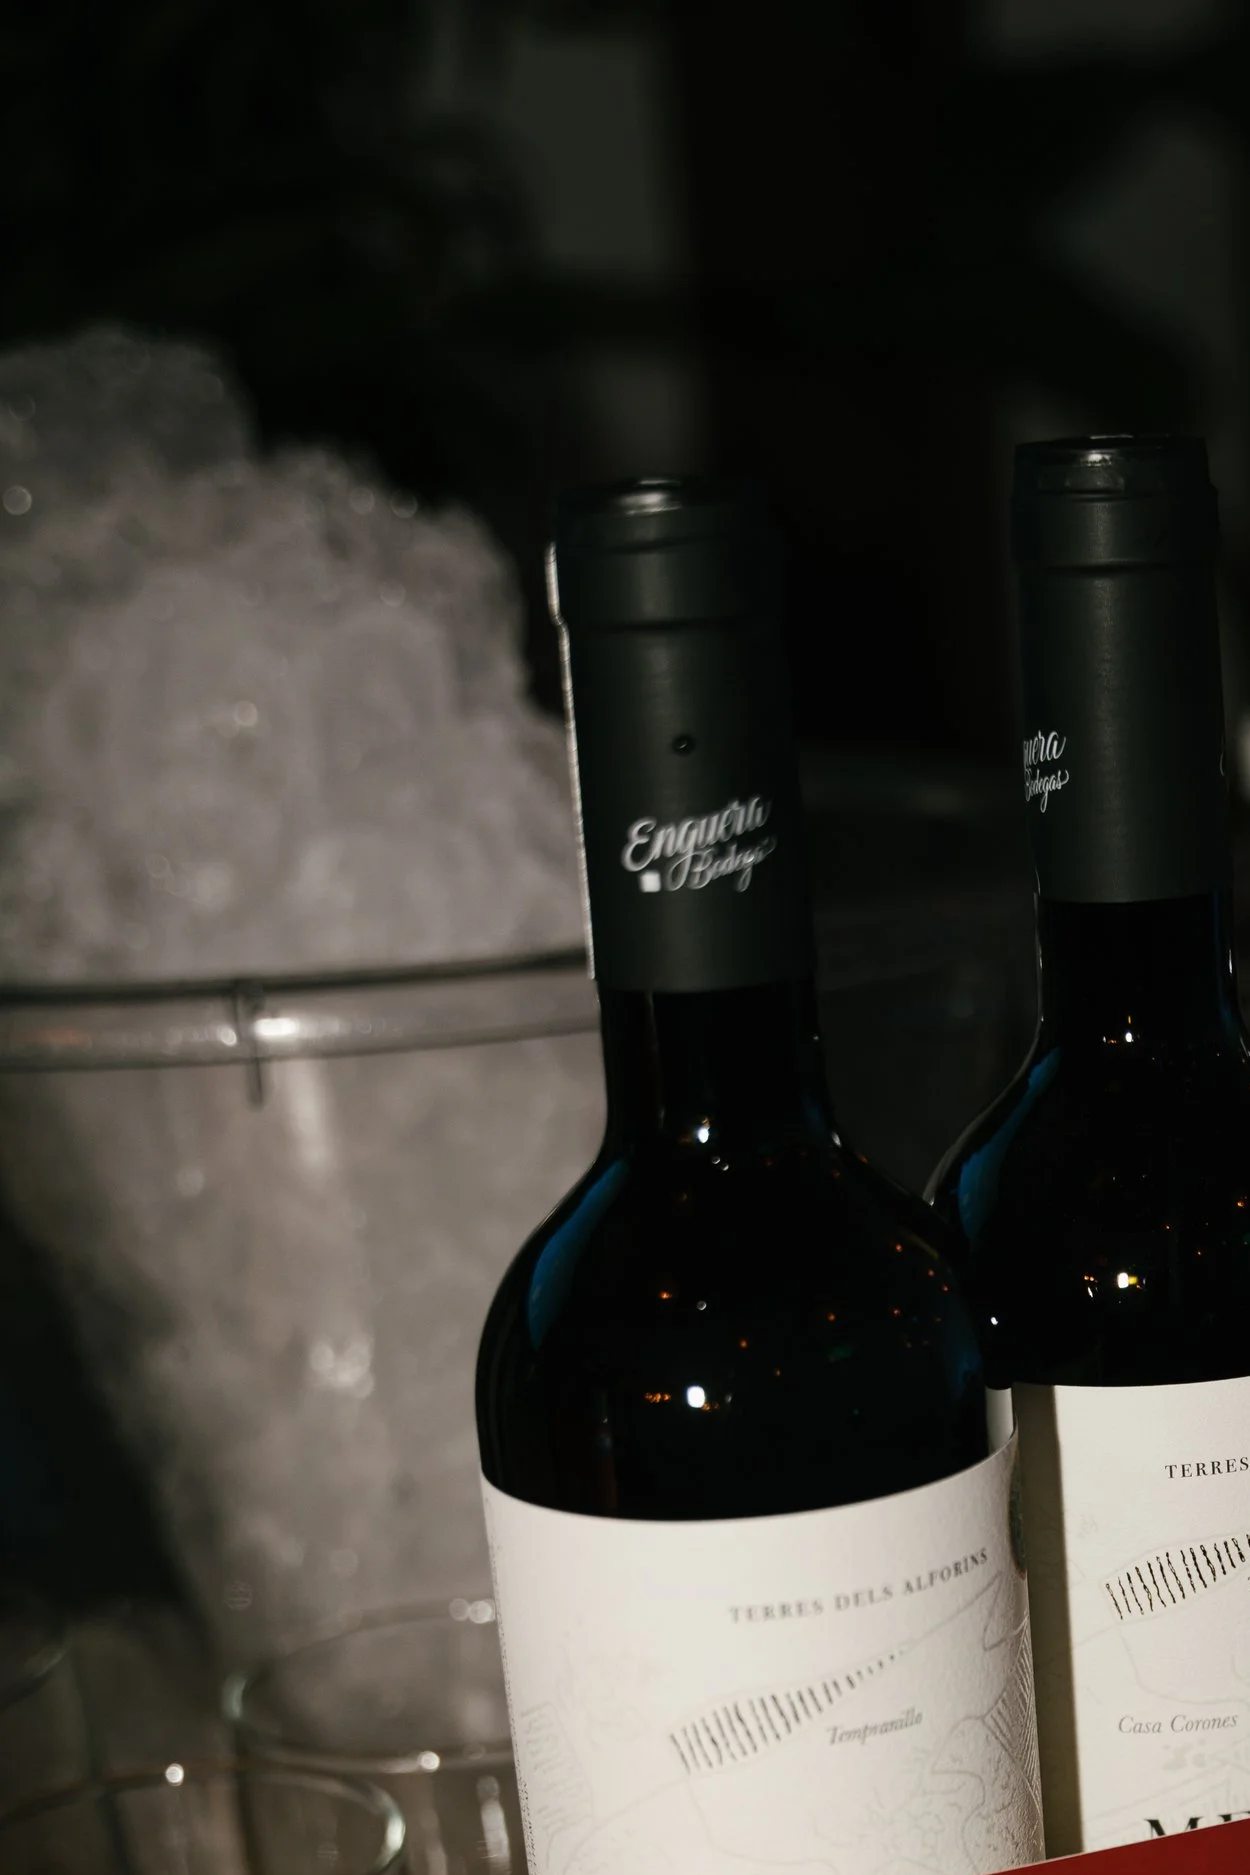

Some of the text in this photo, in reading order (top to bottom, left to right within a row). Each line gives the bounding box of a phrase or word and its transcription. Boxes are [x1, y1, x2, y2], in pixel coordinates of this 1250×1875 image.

[620, 793, 773, 892] Enguera
[1165, 1456, 1250, 1479] TERRES
[729, 1547, 988, 1624] TERRES DELS ALFORINS
[826, 1706, 924, 1746] Tempranillo
[1118, 1713, 1239, 1734] Casa Corones
